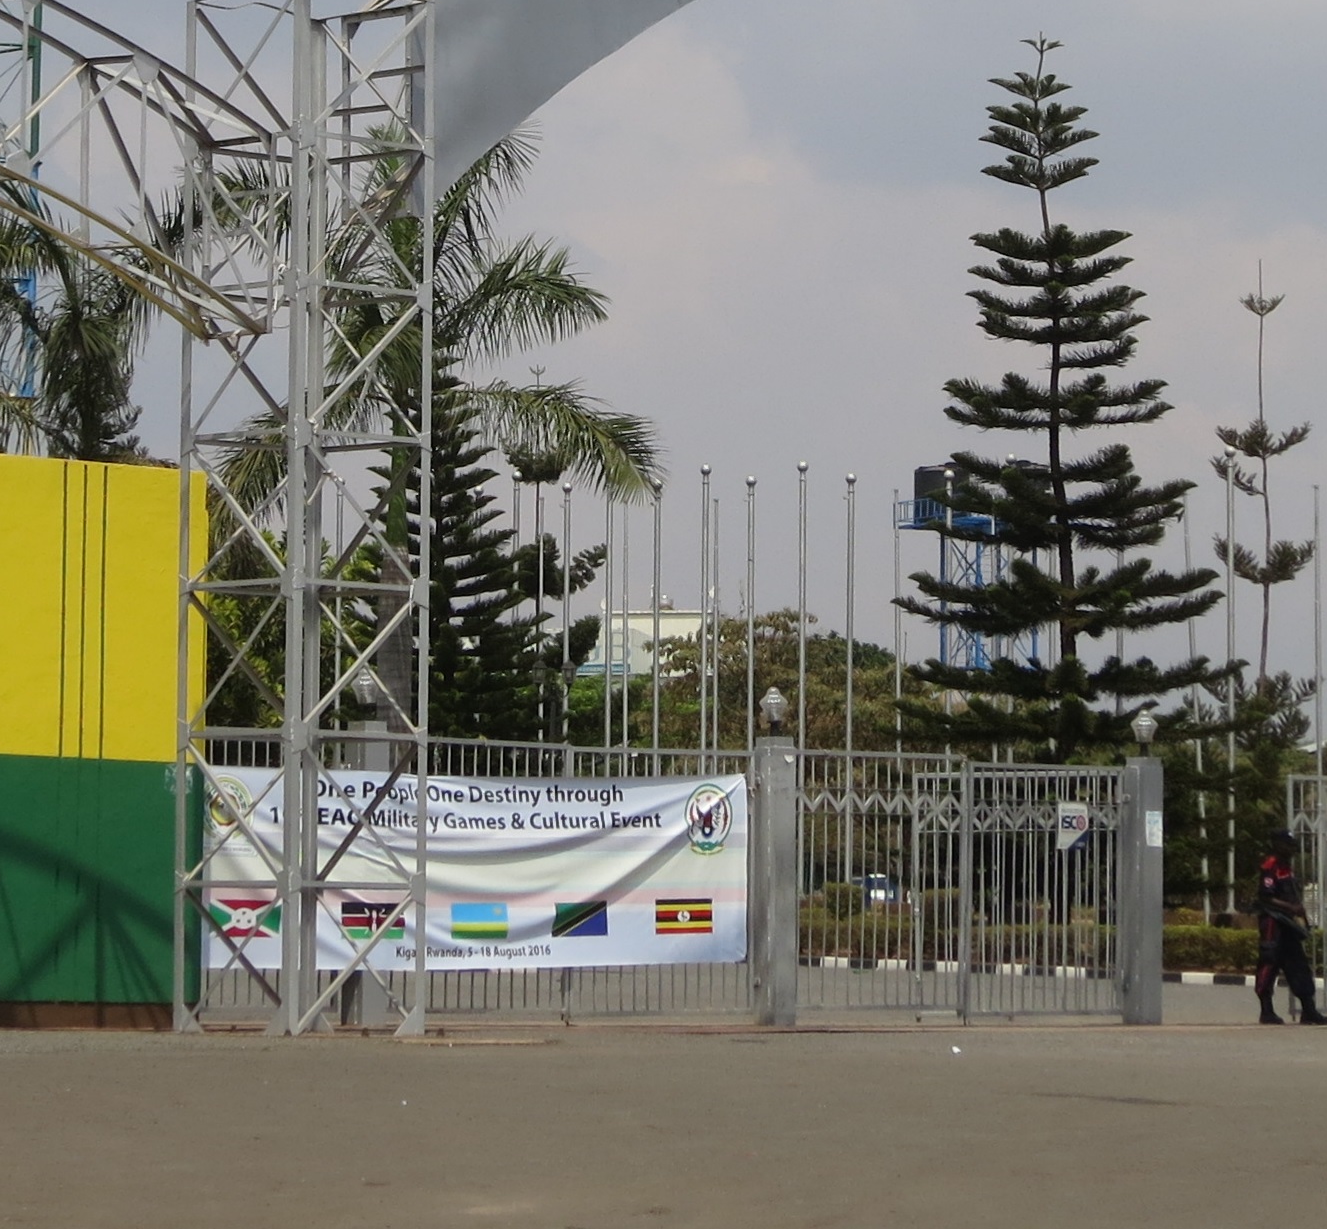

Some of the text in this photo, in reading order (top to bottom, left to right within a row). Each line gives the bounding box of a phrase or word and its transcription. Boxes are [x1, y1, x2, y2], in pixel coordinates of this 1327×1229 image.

[427, 784, 464, 803] One
[469, 784, 541, 807] Destiny
[546, 784, 624, 807] through
[369, 808, 440, 833] Militay
[443, 811, 506, 830] Games
[511, 812, 525, 830] &
[530, 811, 606, 830] Cultural
[611, 812, 662, 829] Event
[493, 945, 527, 960] August
